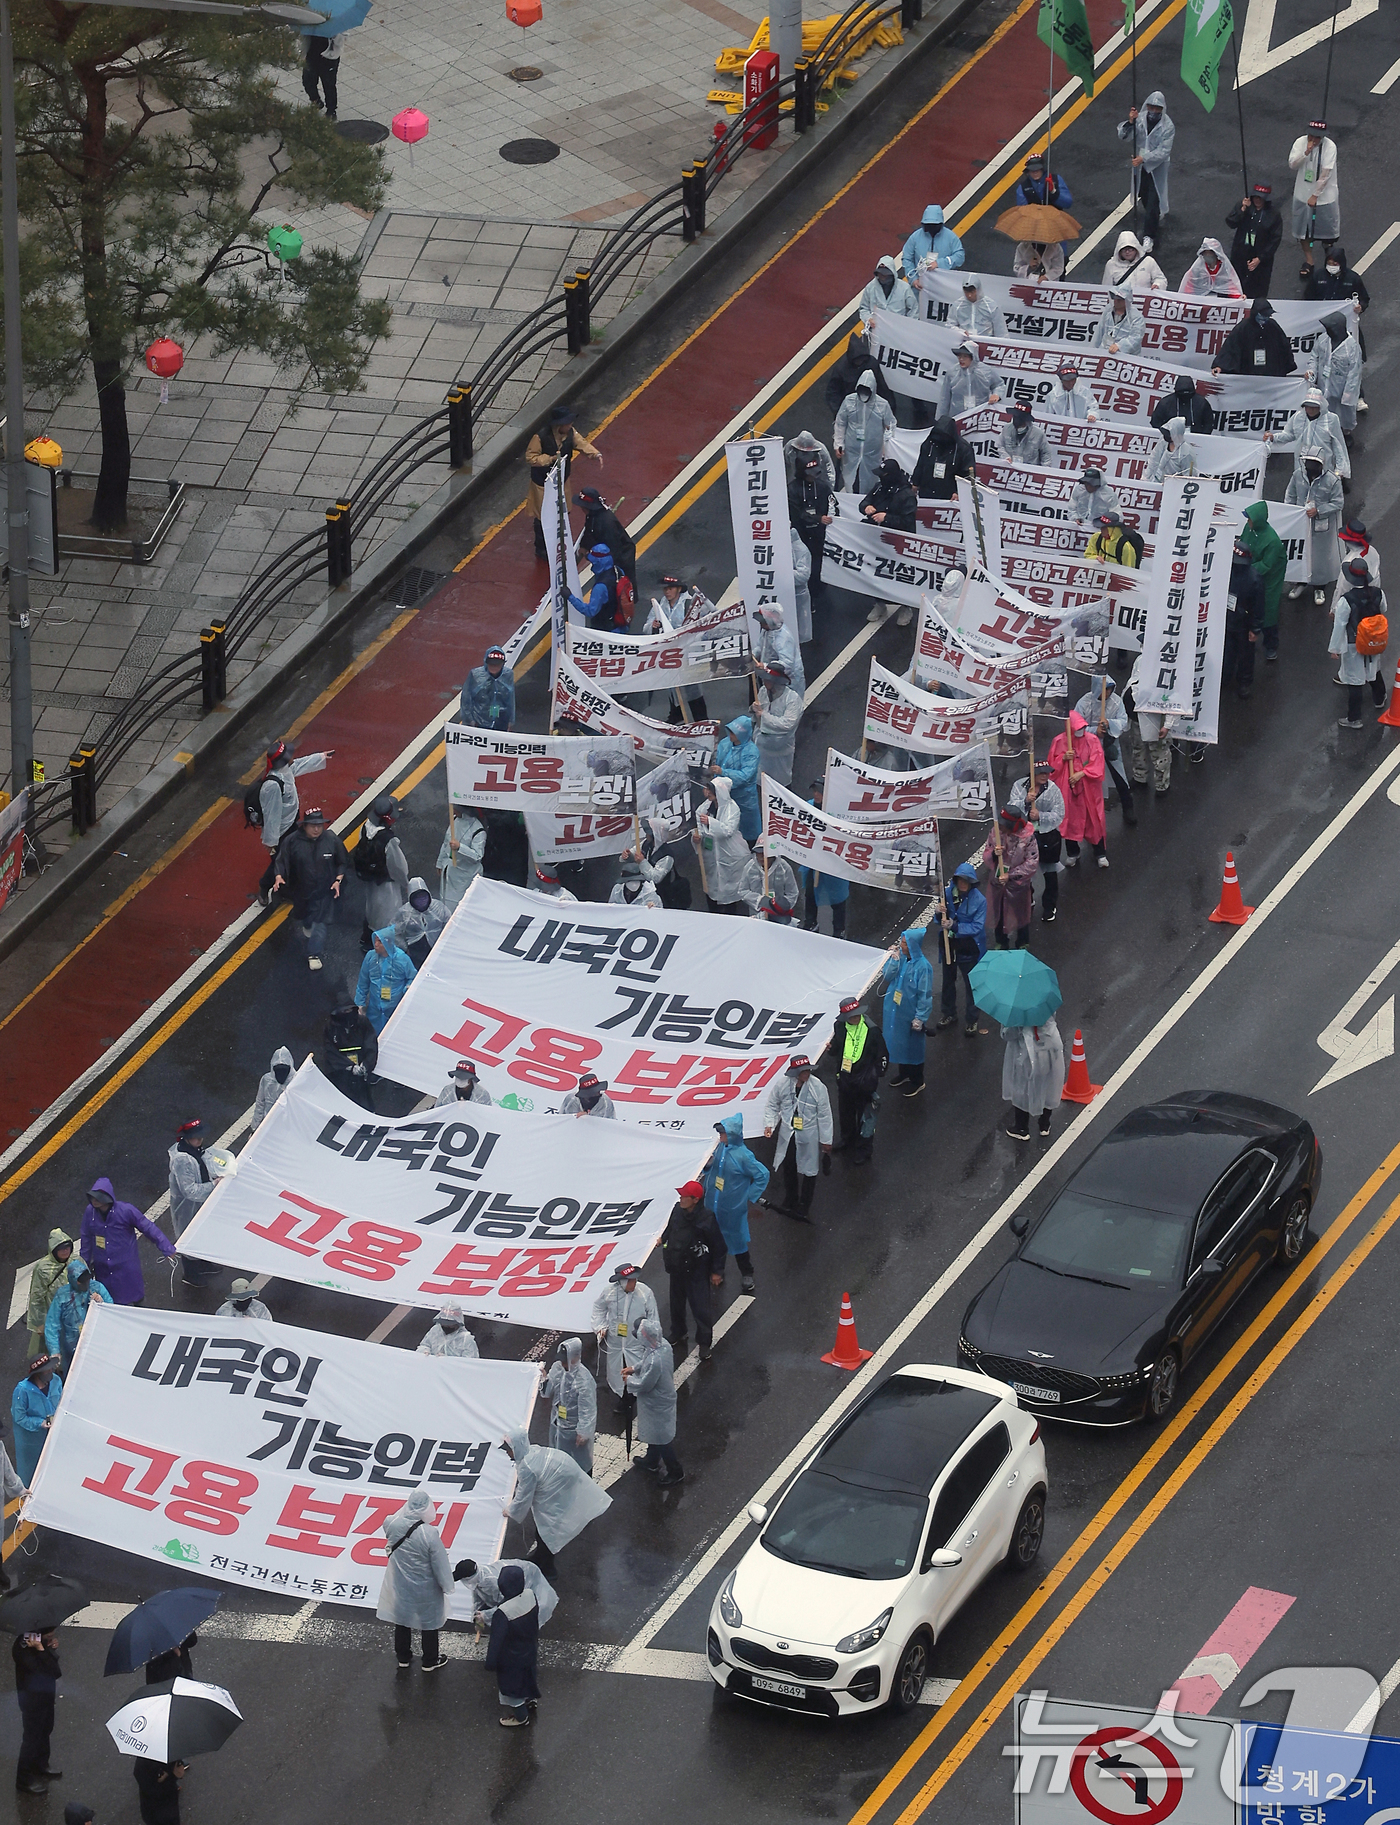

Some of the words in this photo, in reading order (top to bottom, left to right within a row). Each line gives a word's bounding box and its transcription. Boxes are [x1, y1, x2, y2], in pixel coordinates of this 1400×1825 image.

[1033, 288, 1145, 314] 건설노동도
[1148, 297, 1202, 323] 일하고
[1206, 306, 1244, 325] 싶다
[1141, 323, 1188, 353] 고용
[982, 345, 1100, 377] 건설노동자도
[1101, 358, 1158, 393] 일하고
[1090, 383, 1141, 416] 고용
[960, 411, 1064, 442] 건설노도
[1067, 428, 1124, 451] 일하고
[988, 467, 1076, 500] 건설노동자
[1115, 458, 1146, 480] 대
[1012, 558, 1070, 585] 일하고
[1072, 567, 1112, 590] 싶다
[572, 641, 603, 656] 건설
[979, 598, 1061, 648] 고용
[1065, 636, 1110, 665] 장!
[631, 647, 685, 675] 고용
[871, 679, 900, 701] 건설
[867, 696, 919, 735] 불법
[922, 717, 976, 743] 고용
[446, 731, 488, 748] 내국인
[490, 742, 547, 756] 기능인력
[473, 755, 564, 794] 고용
[558, 774, 633, 806] 보장!
[848, 776, 934, 812] 고용
[554, 813, 633, 846] 고용
[875, 847, 936, 877] 근절!
[497, 914, 680, 983] 내국인
[595, 985, 825, 1050] 기능인력
[430, 998, 603, 1092] 고용
[606, 1048, 791, 1107] 보장!
[316, 1114, 501, 1181] 내국인
[415, 1182, 654, 1241] 기능인력
[244, 1189, 423, 1282] 고용
[418, 1241, 619, 1298] 보장!
[131, 1332, 323, 1407] 내국인
[1037, 1389, 1059, 1400] 7769
[246, 1409, 491, 1493] 기능인력
[82, 1433, 260, 1536] 고용
[210, 1553, 369, 1600] 전국건설노동조합
[756, 1678, 774, 1690] 09수
[777, 1684, 801, 1696] 6849
[1257, 1763, 1377, 1805] 청계2가
